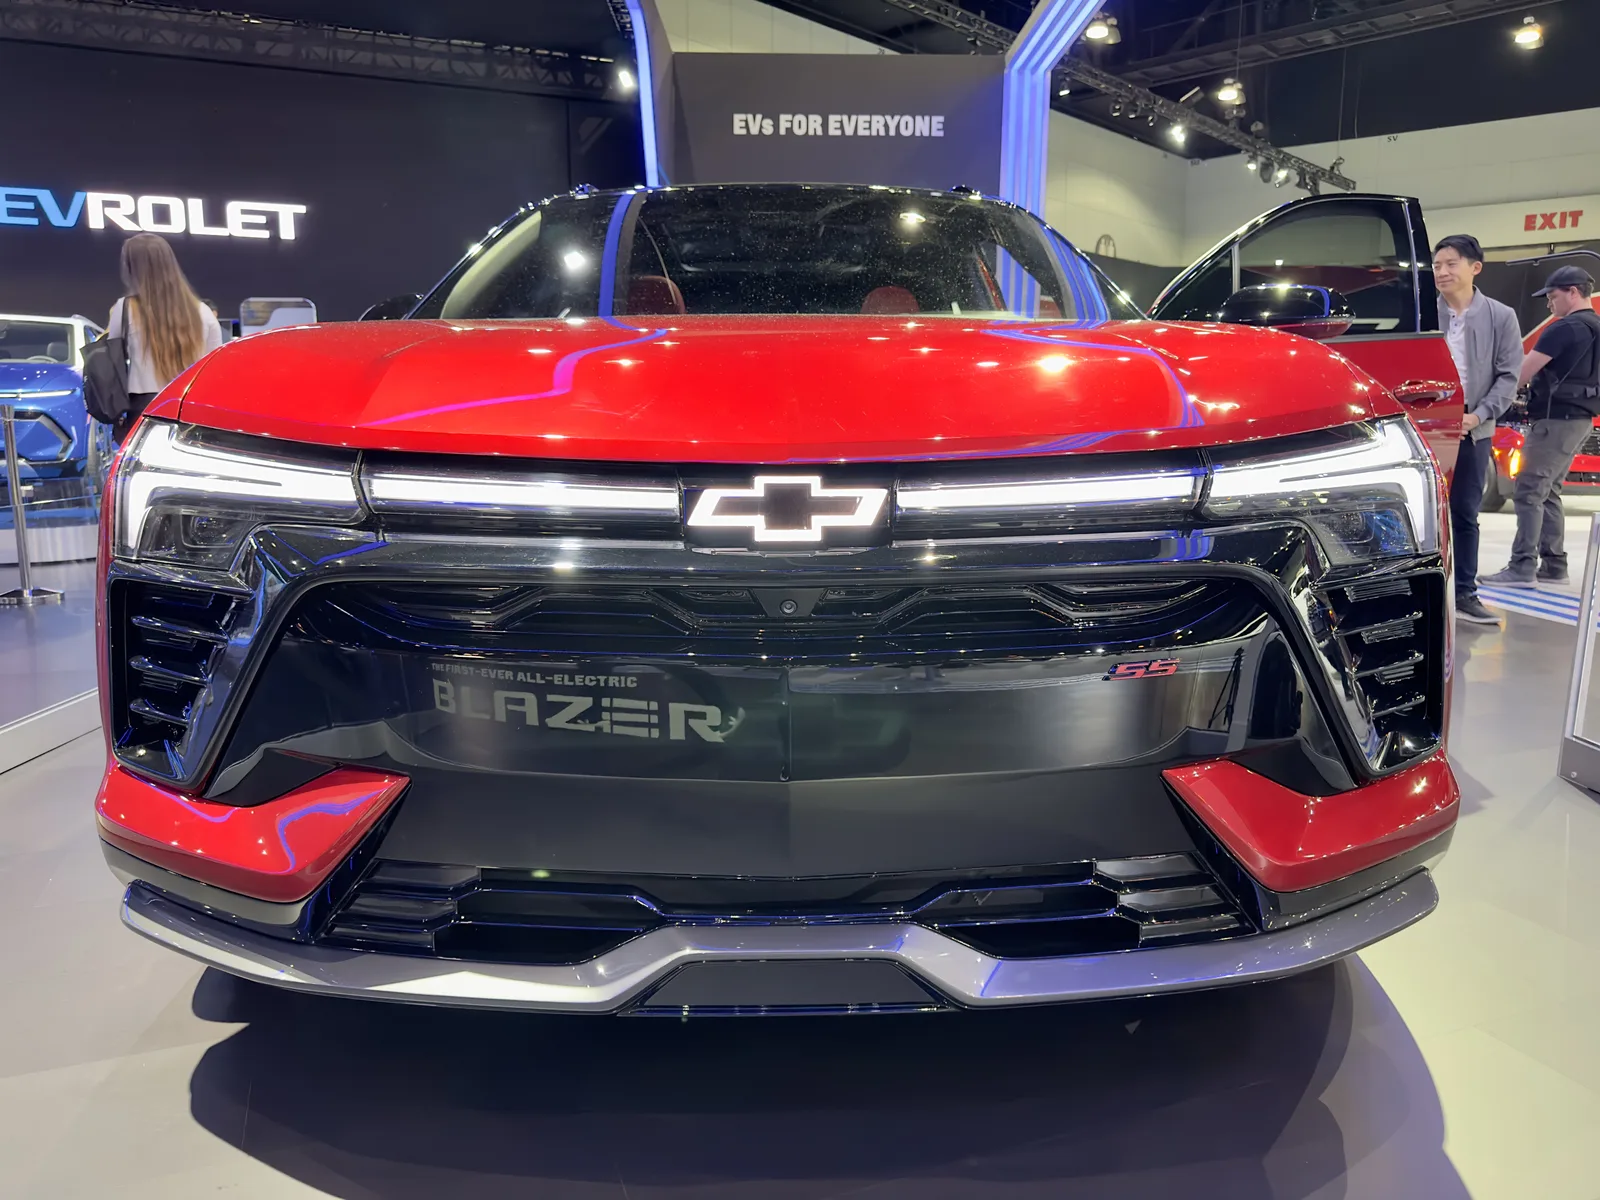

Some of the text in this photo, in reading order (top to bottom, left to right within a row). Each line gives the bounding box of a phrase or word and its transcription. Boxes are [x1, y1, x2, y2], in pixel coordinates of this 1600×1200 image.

[733, 113, 944, 137] EVs FOR EVERYONE
[1524, 210, 1583, 232] EXIT
[432, 662, 638, 688] THE FIRST-EVER ALL-ELECTRIC
[1106, 658, 1181, 681] SS
[433, 678, 725, 743] BLAZER
